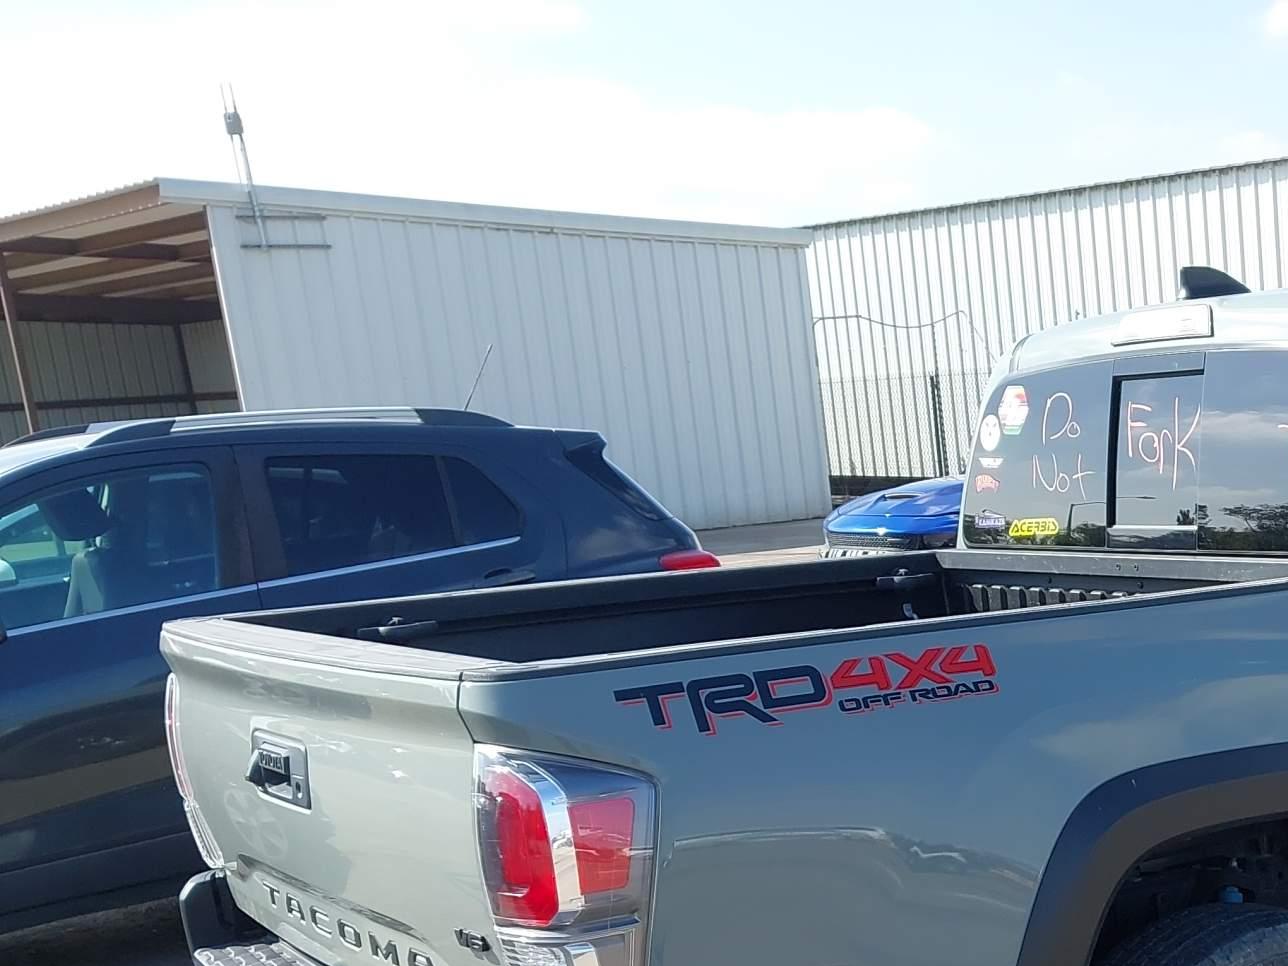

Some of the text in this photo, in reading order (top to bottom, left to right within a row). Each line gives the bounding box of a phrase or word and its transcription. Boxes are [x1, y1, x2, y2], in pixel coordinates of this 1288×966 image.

[1042, 391, 1081, 446] Do
[1032, 452, 1097, 500] Not
[613, 643, 998, 736] TRD 4X4
[837, 678, 1000, 715] OFF ROAD
[453, 927, 491, 953] V6
